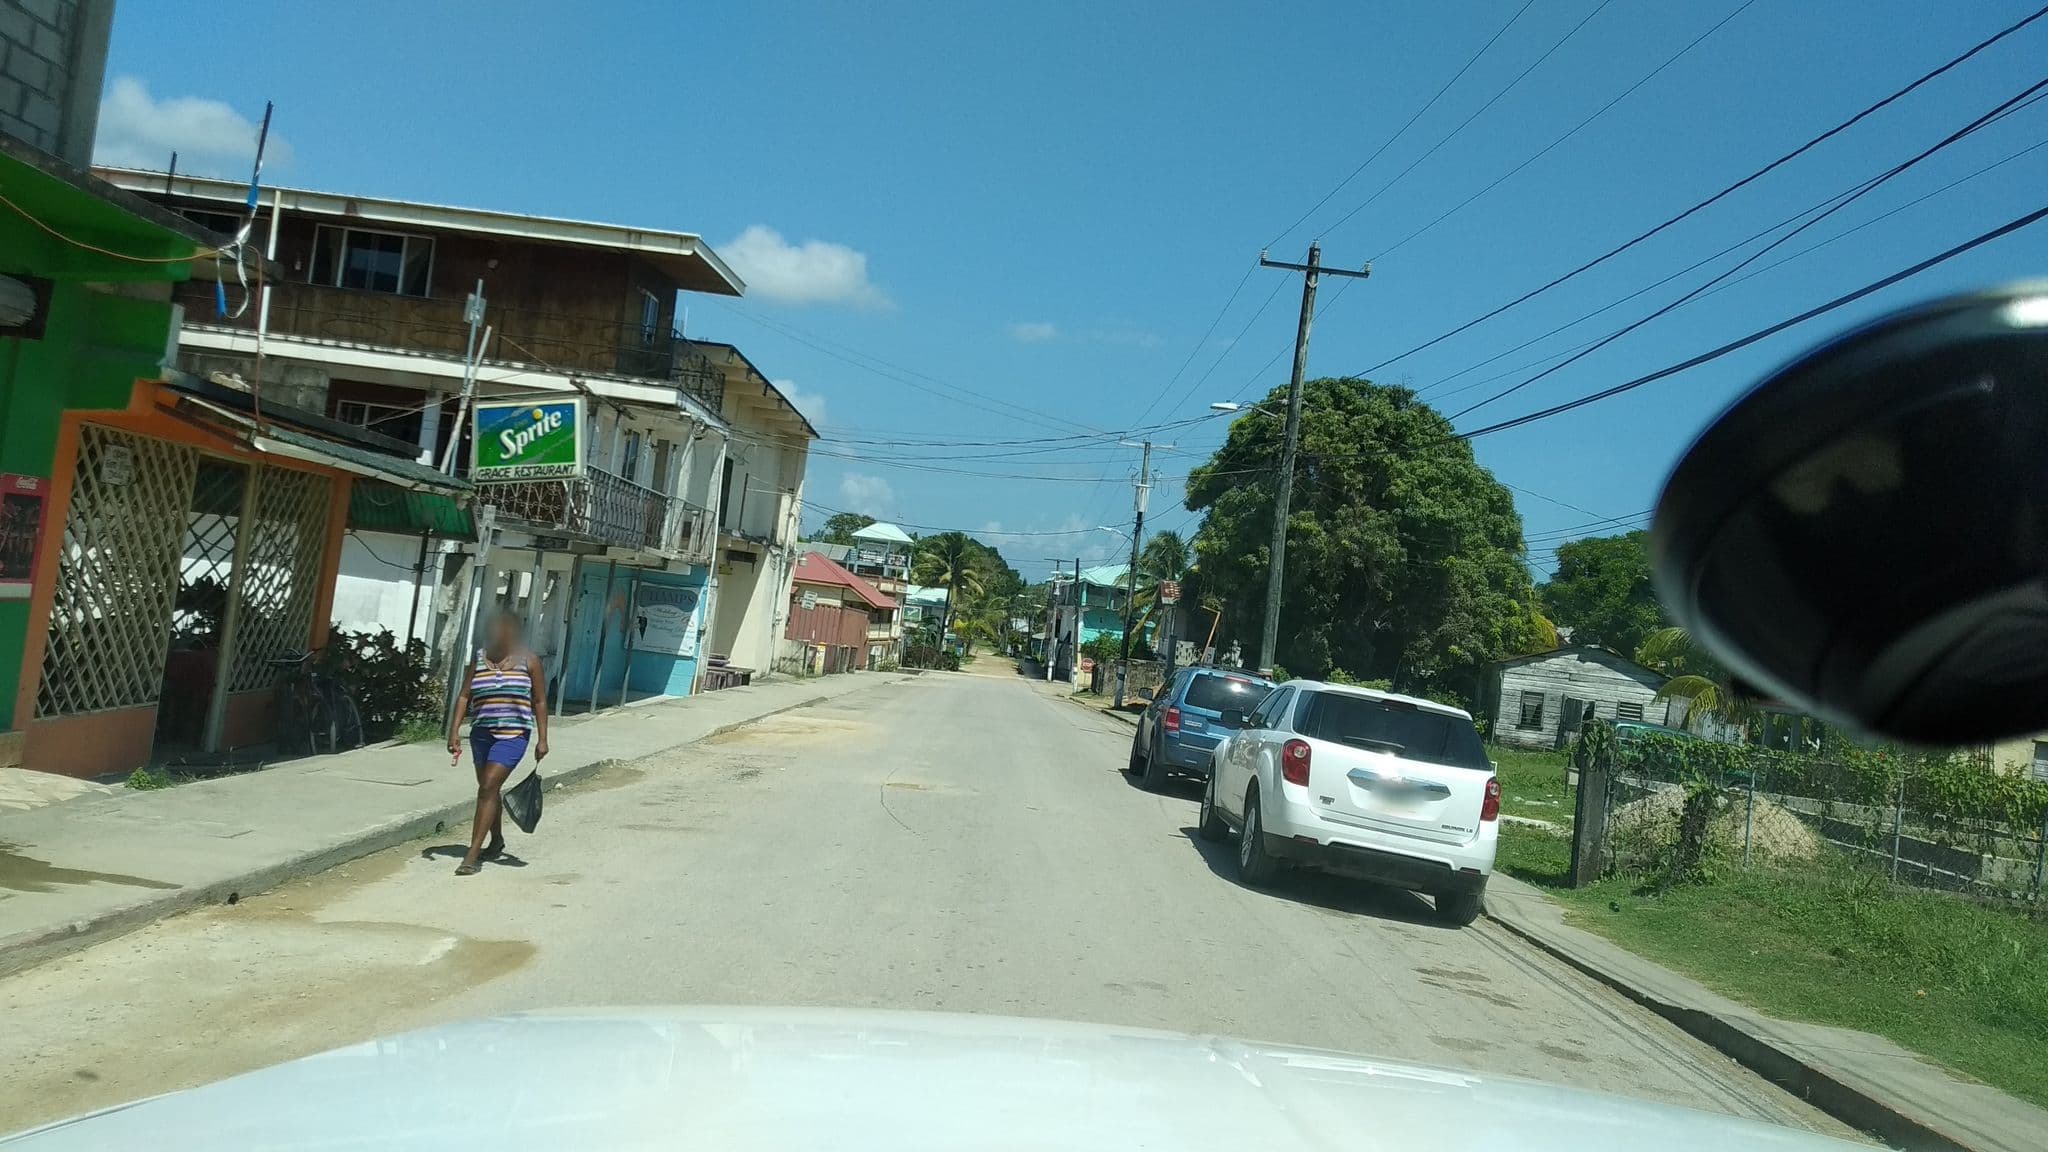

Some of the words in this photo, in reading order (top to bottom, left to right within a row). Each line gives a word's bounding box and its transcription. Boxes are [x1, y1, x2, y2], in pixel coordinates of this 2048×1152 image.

[500, 408, 562, 459] Sprite
[478, 467, 510, 479] GRACE
[513, 464, 577, 478] RESTAURANT
